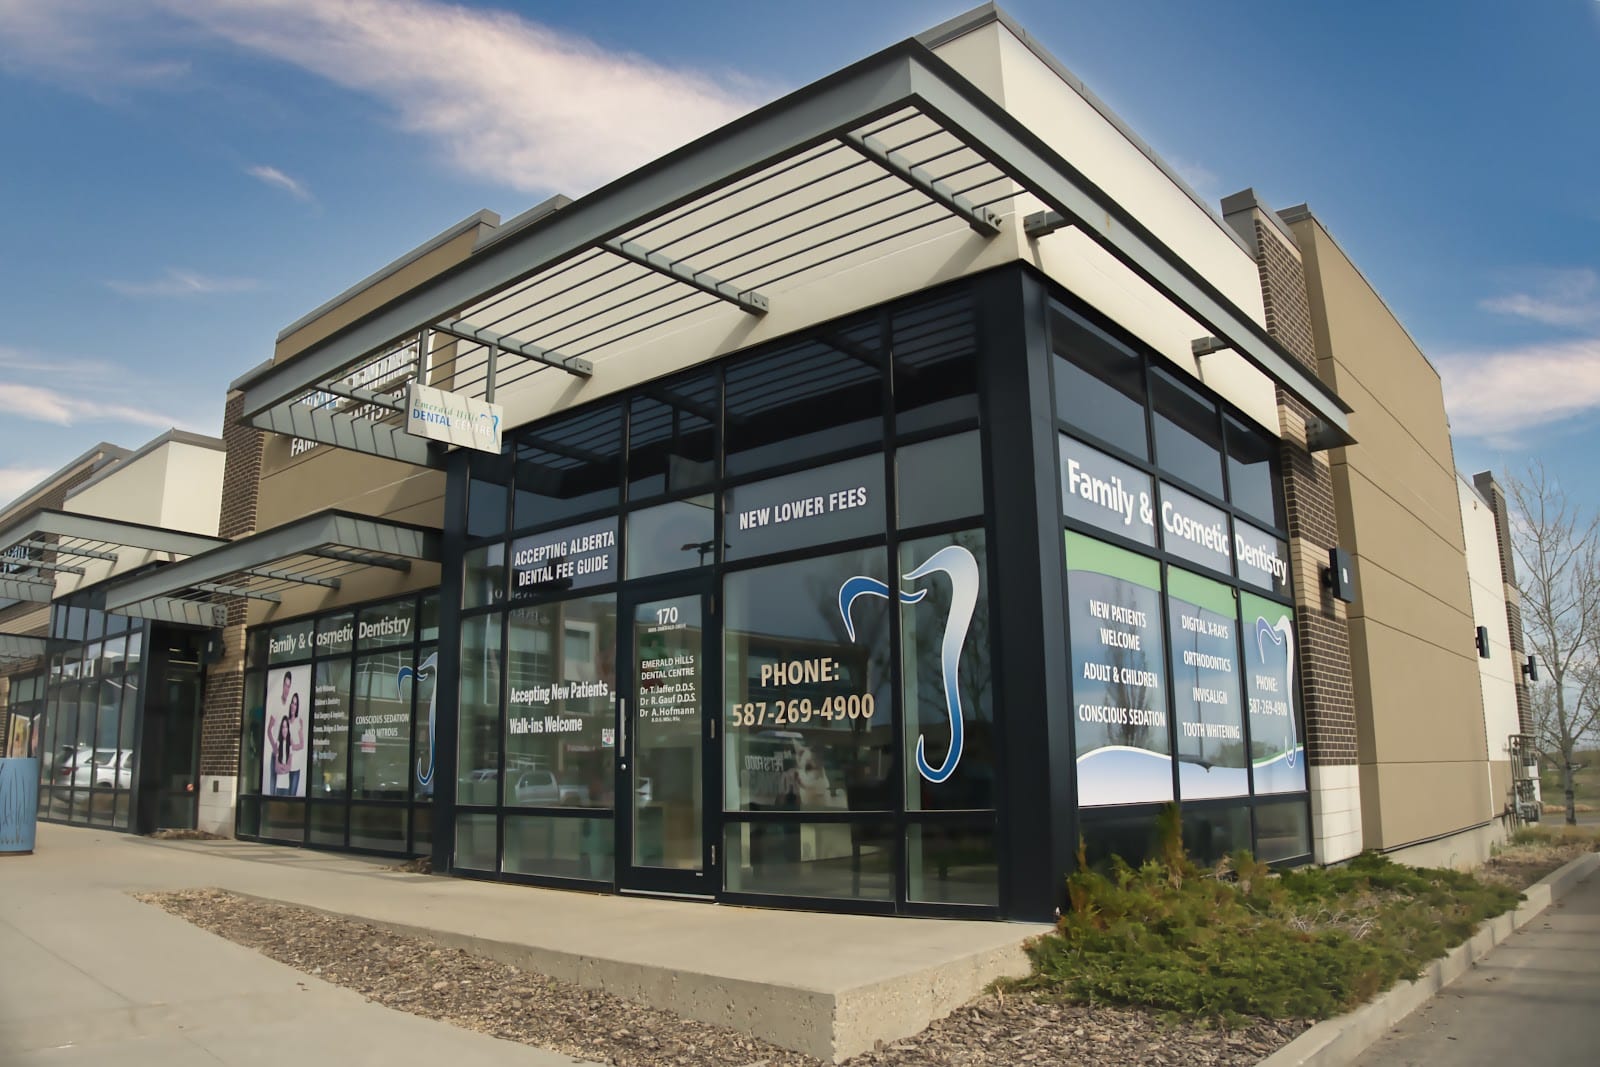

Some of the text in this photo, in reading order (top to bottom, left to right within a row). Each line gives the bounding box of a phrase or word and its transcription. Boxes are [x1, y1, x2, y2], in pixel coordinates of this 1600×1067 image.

[413, 408, 452, 427] DENTAL
[739, 486, 867, 530] NEW LOWER FEES
[1068, 458, 1287, 586] Family & Cosmetic Dentistry
[514, 531, 615, 567] ACCEPTING ALBERTA
[519, 555, 609, 587] DENTAL FEE GUIDE
[656, 606, 678, 625] 170
[1089, 599, 1147, 627] NEW PATIENTS
[269, 616, 411, 654] Family & Cosmetic Dentistry
[1181, 615, 1228, 639] DIGITAL X-RAYS
[1100, 627, 1140, 650] WELCOME
[642, 655, 694, 669] EMERALD HILLS
[761, 657, 840, 687] PHONE:
[1183, 650, 1231, 672] ORTHODONTICS
[641, 667, 695, 681] DENTAL CENTRE
[1084, 661, 1158, 688] ADULT & CHILDREN
[1255, 675, 1278, 692] PHONE:
[510, 680, 608, 706] Accepting New Patients
[640, 687, 648, 695] Dr
[640, 697, 648, 706] Dr
[1192, 687, 1228, 704] INVISALIGN
[355, 715, 383, 725] CONSCIOUS
[384, 713, 410, 723] SEDATION
[640, 709, 648, 717] Dr
[732, 693, 875, 726] 587-269-4900
[1079, 704, 1166, 727] CONSCIOUS SEDATION
[509, 717, 543, 734] Walk-ins
[544, 715, 583, 733] Welcome
[1182, 722, 1240, 739] TOOTH WHITENING
